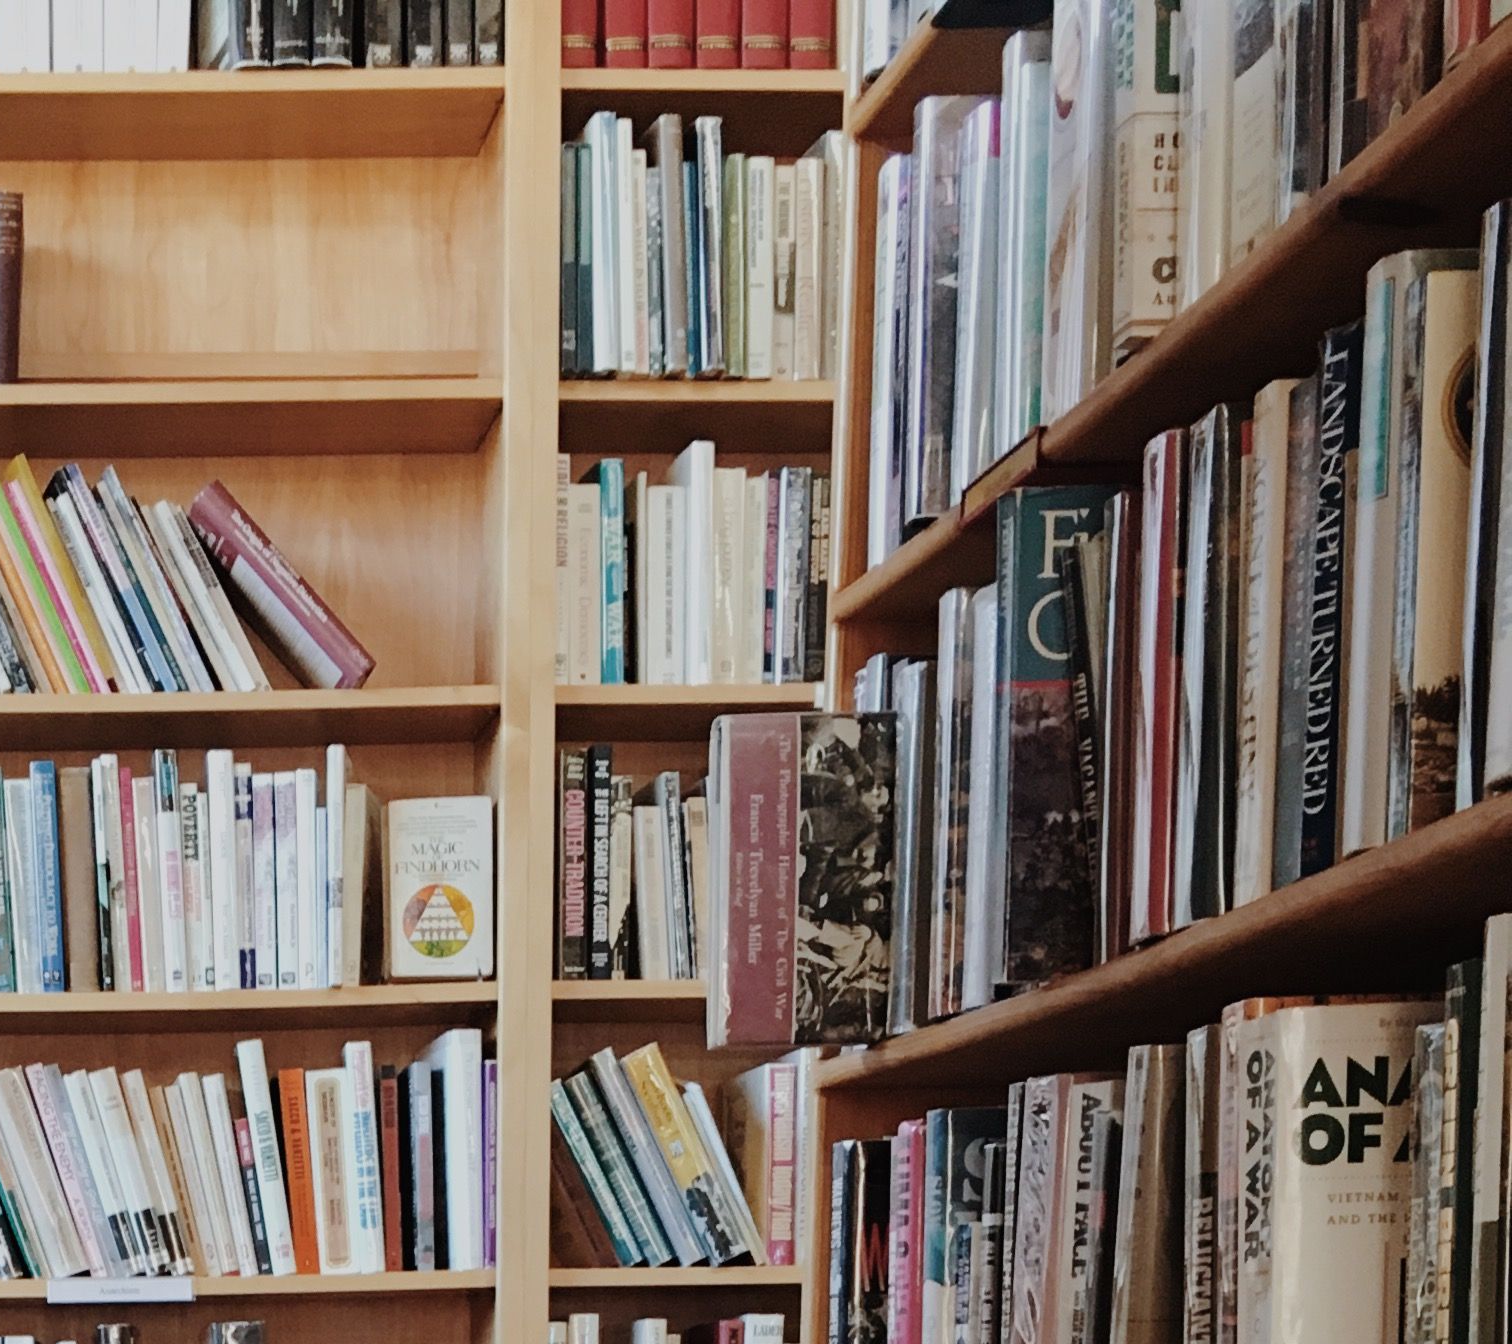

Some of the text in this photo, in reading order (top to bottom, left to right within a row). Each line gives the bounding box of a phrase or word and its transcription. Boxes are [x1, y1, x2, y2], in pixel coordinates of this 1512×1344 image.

[1302, 349, 1351, 816] LANDSCAPE TURNED RED
[182, 795, 198, 861] POVERTY
[594, 798, 607, 824] LEFT
[594, 824, 607, 838] IN
[395, 859, 481, 875] FINDHORN
[410, 841, 464, 857] MAGIC
[564, 789, 586, 938] COUNTER-TRADITION
[594, 839, 608, 878] SEARCH
[594, 879, 608, 894] OF
[745, 793, 764, 966] Francis Trevelyan Miller
[774, 738, 793, 1020] The Photographic History of The Civil War
[593, 904, 608, 943] CENTER
[32, 1069, 76, 1182] FACING THE ENEMY
[1300, 1112, 1386, 1165] OF
[1245, 1050, 1265, 1264] OF A WAR
[1261, 1049, 1276, 1259] ANATOMY
[1326, 1212, 1397, 1224] AND THE
